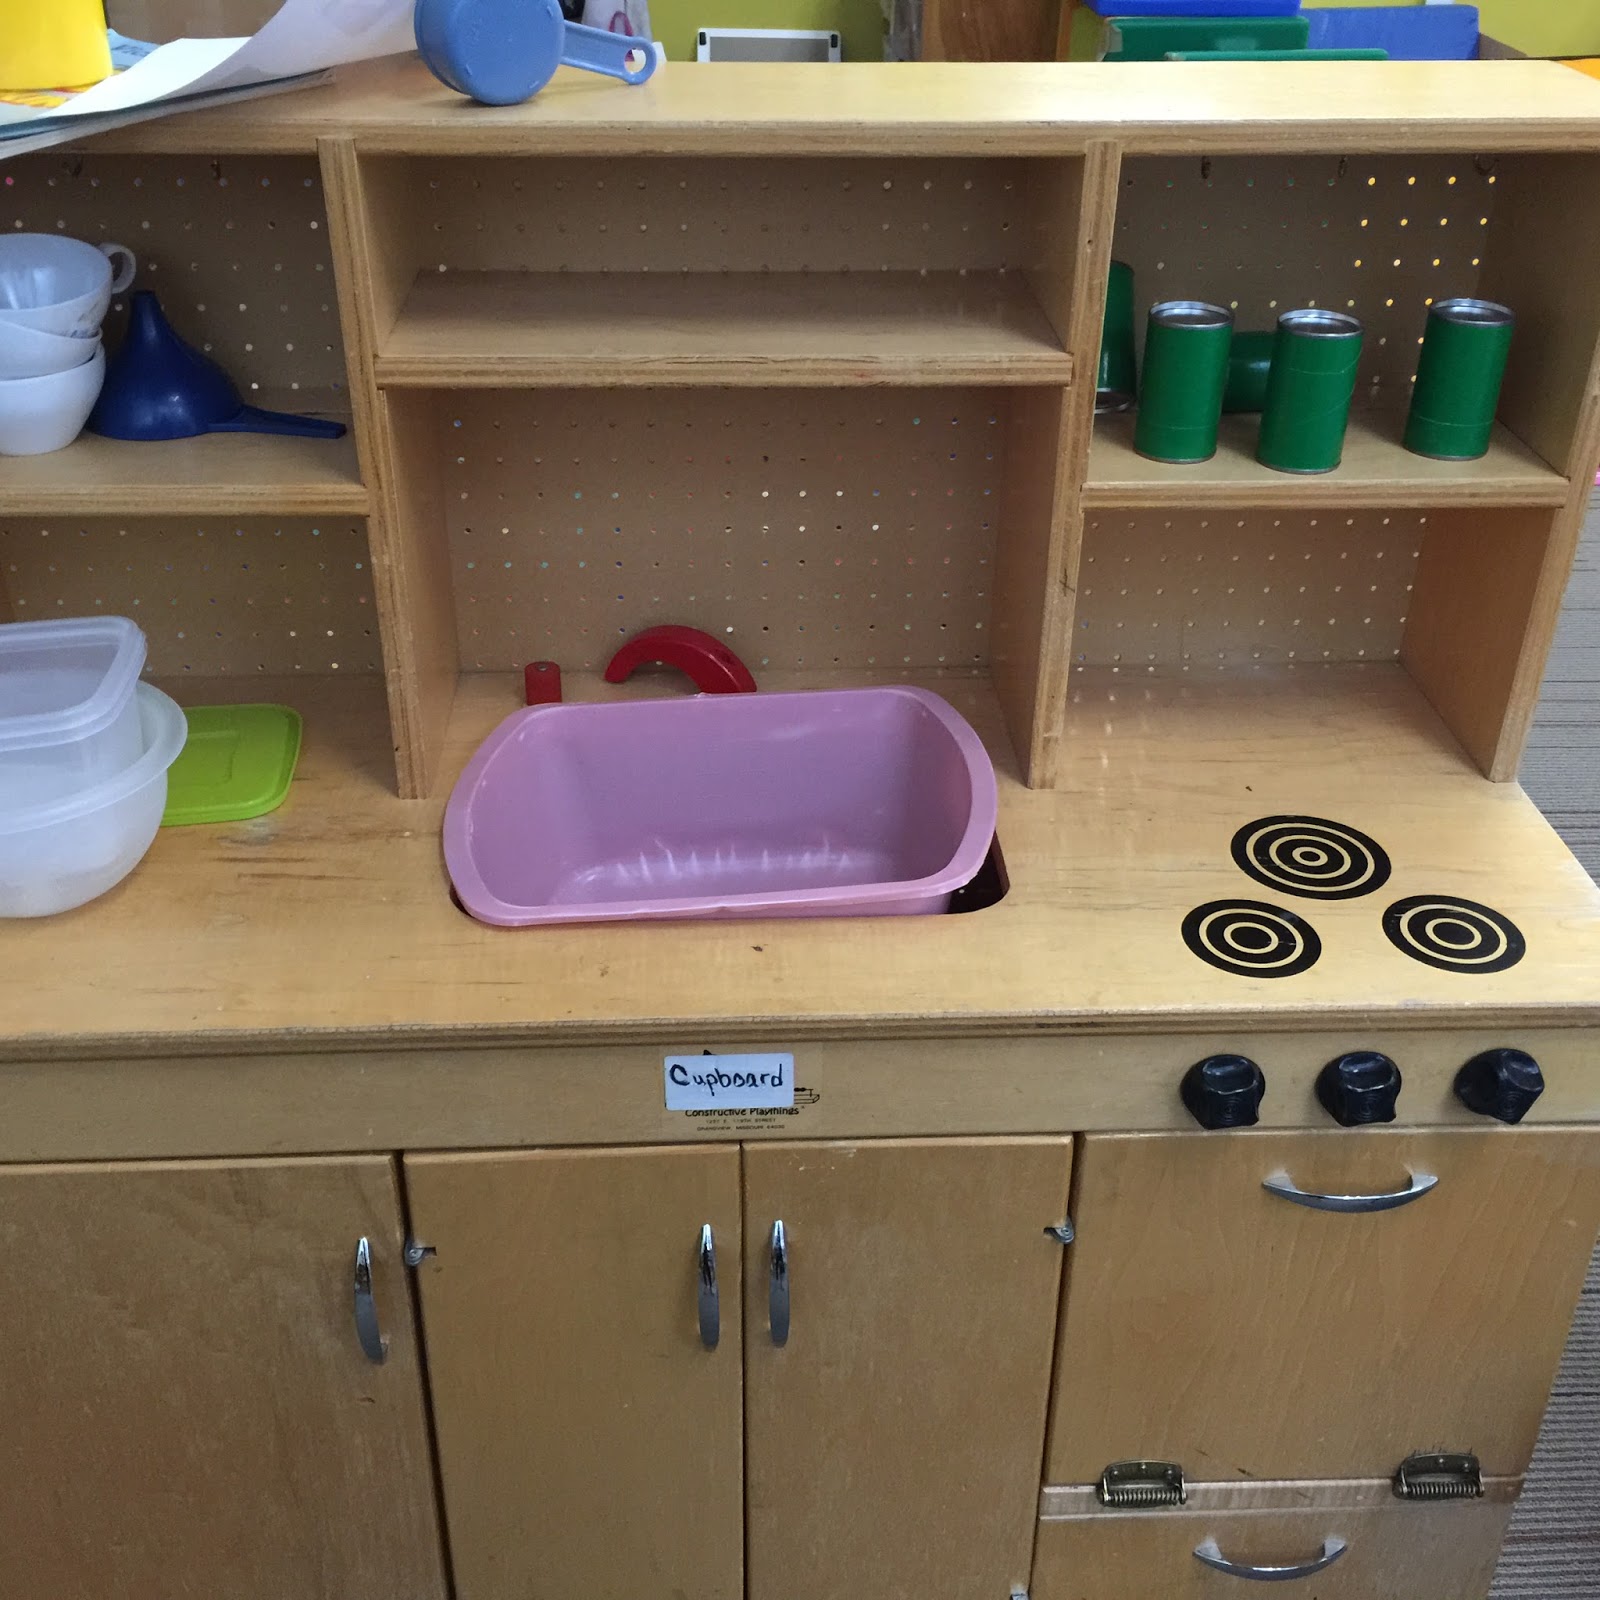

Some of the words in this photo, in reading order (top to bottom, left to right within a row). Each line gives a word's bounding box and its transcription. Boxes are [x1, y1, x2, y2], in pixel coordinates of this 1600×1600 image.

[669, 1063, 783, 1096] Cupboard
[685, 1108, 747, 1117] Constructive
[749, 1107, 800, 1116] Playthings
